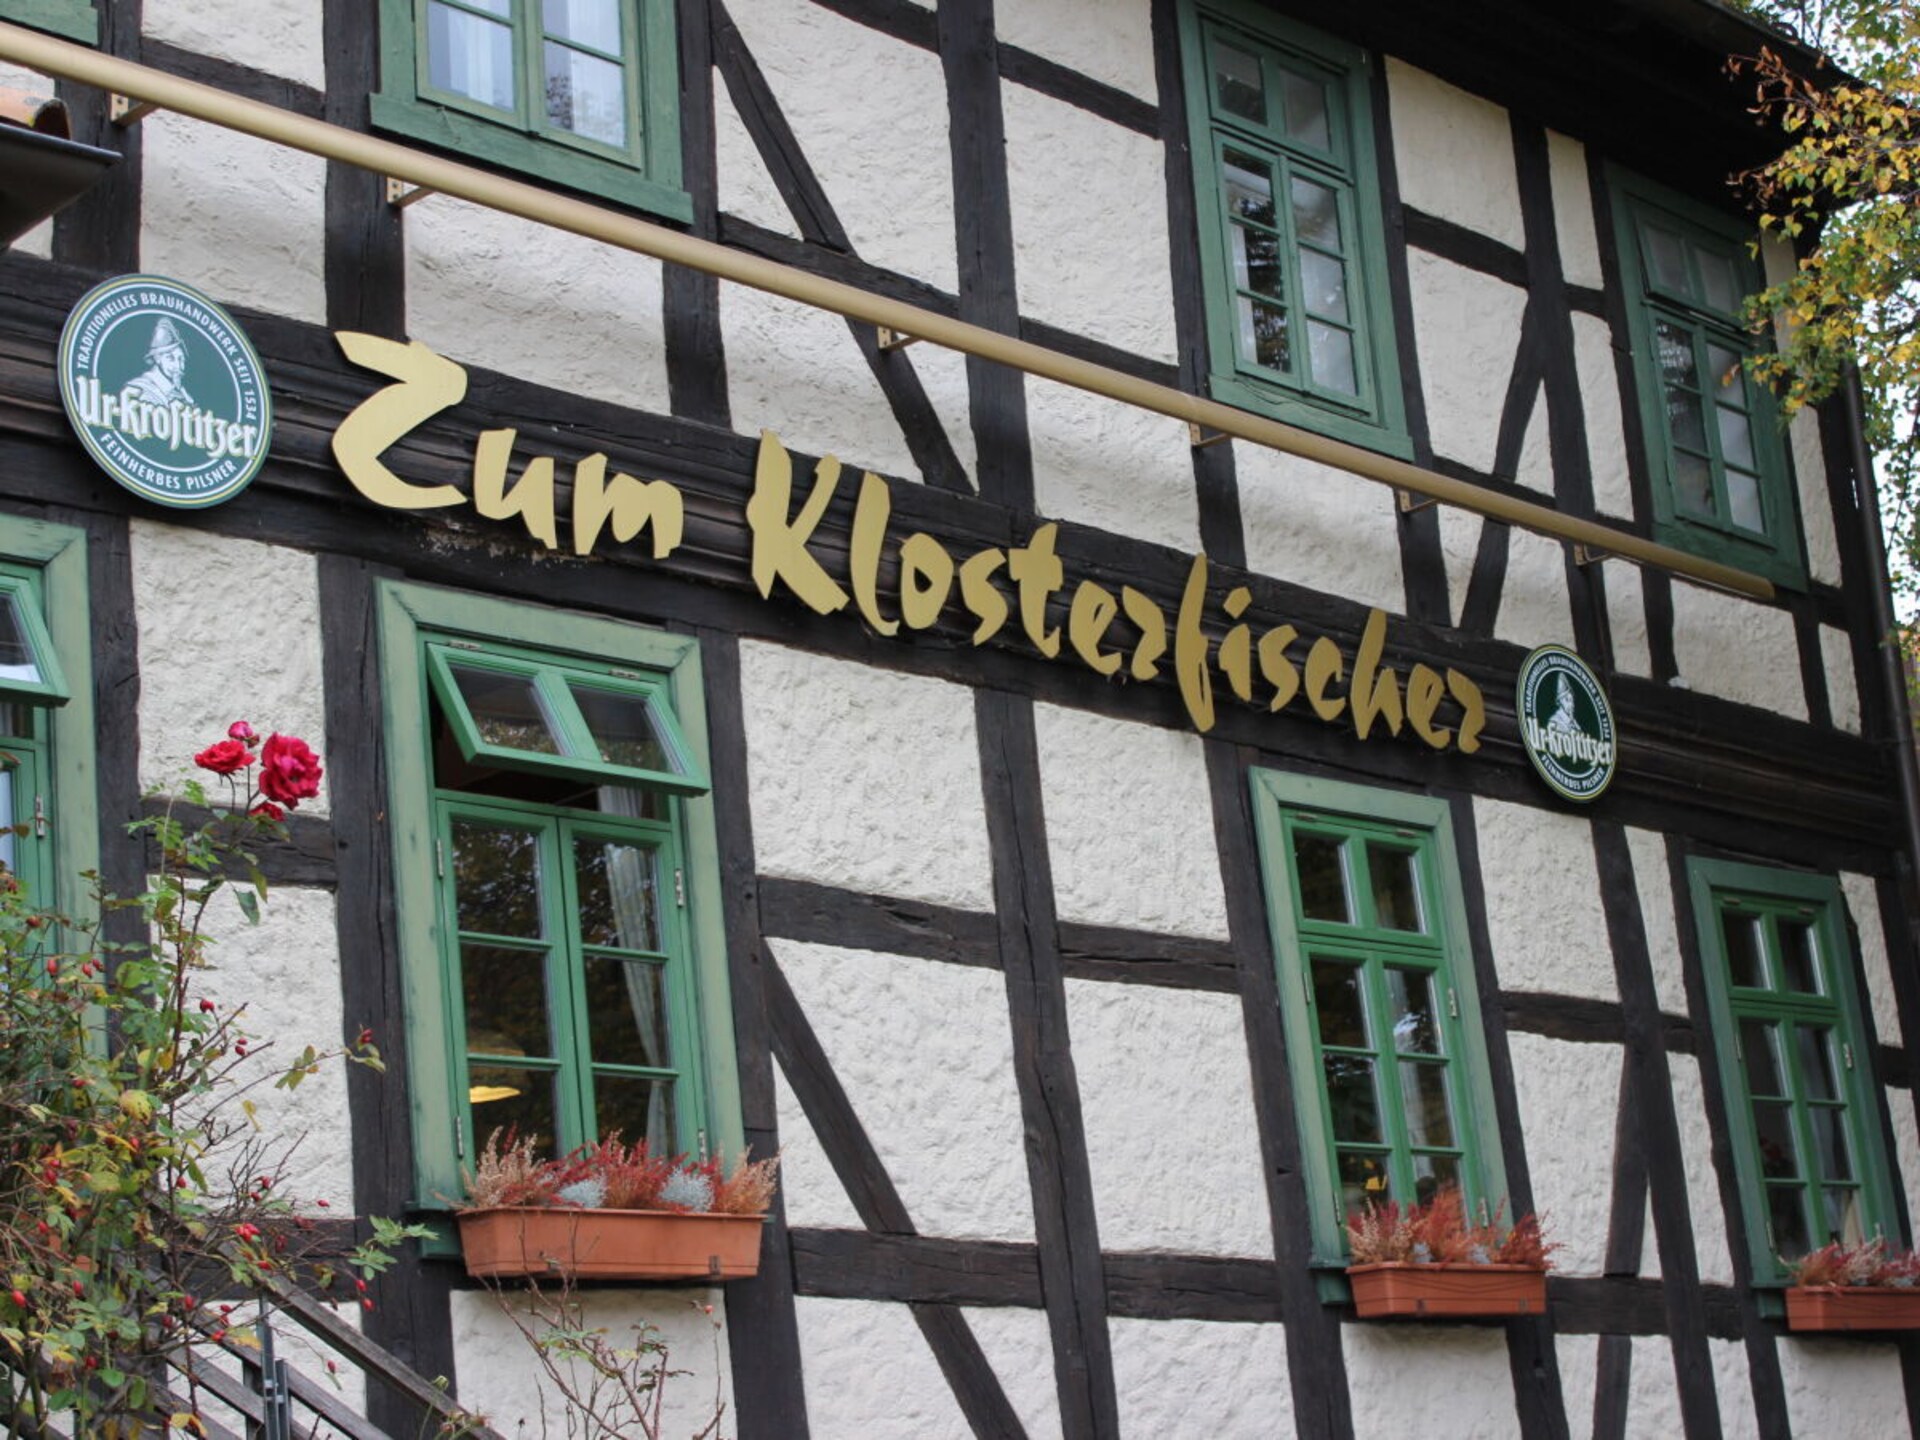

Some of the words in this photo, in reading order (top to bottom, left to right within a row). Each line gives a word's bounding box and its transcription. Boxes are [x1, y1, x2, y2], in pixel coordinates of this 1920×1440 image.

[77, 293, 138, 370] TRADITIONELLES
[140, 292, 238, 356] BRAUHANDWERK
[233, 357, 252, 385] SEIT
[244, 388, 257, 420] 1534
[100, 433, 182, 490] FEINHERBES
[186, 459, 238, 491] PILSNER
[332, 331, 684, 559] Zum
[746, 428, 1487, 755] Klosterfischer
